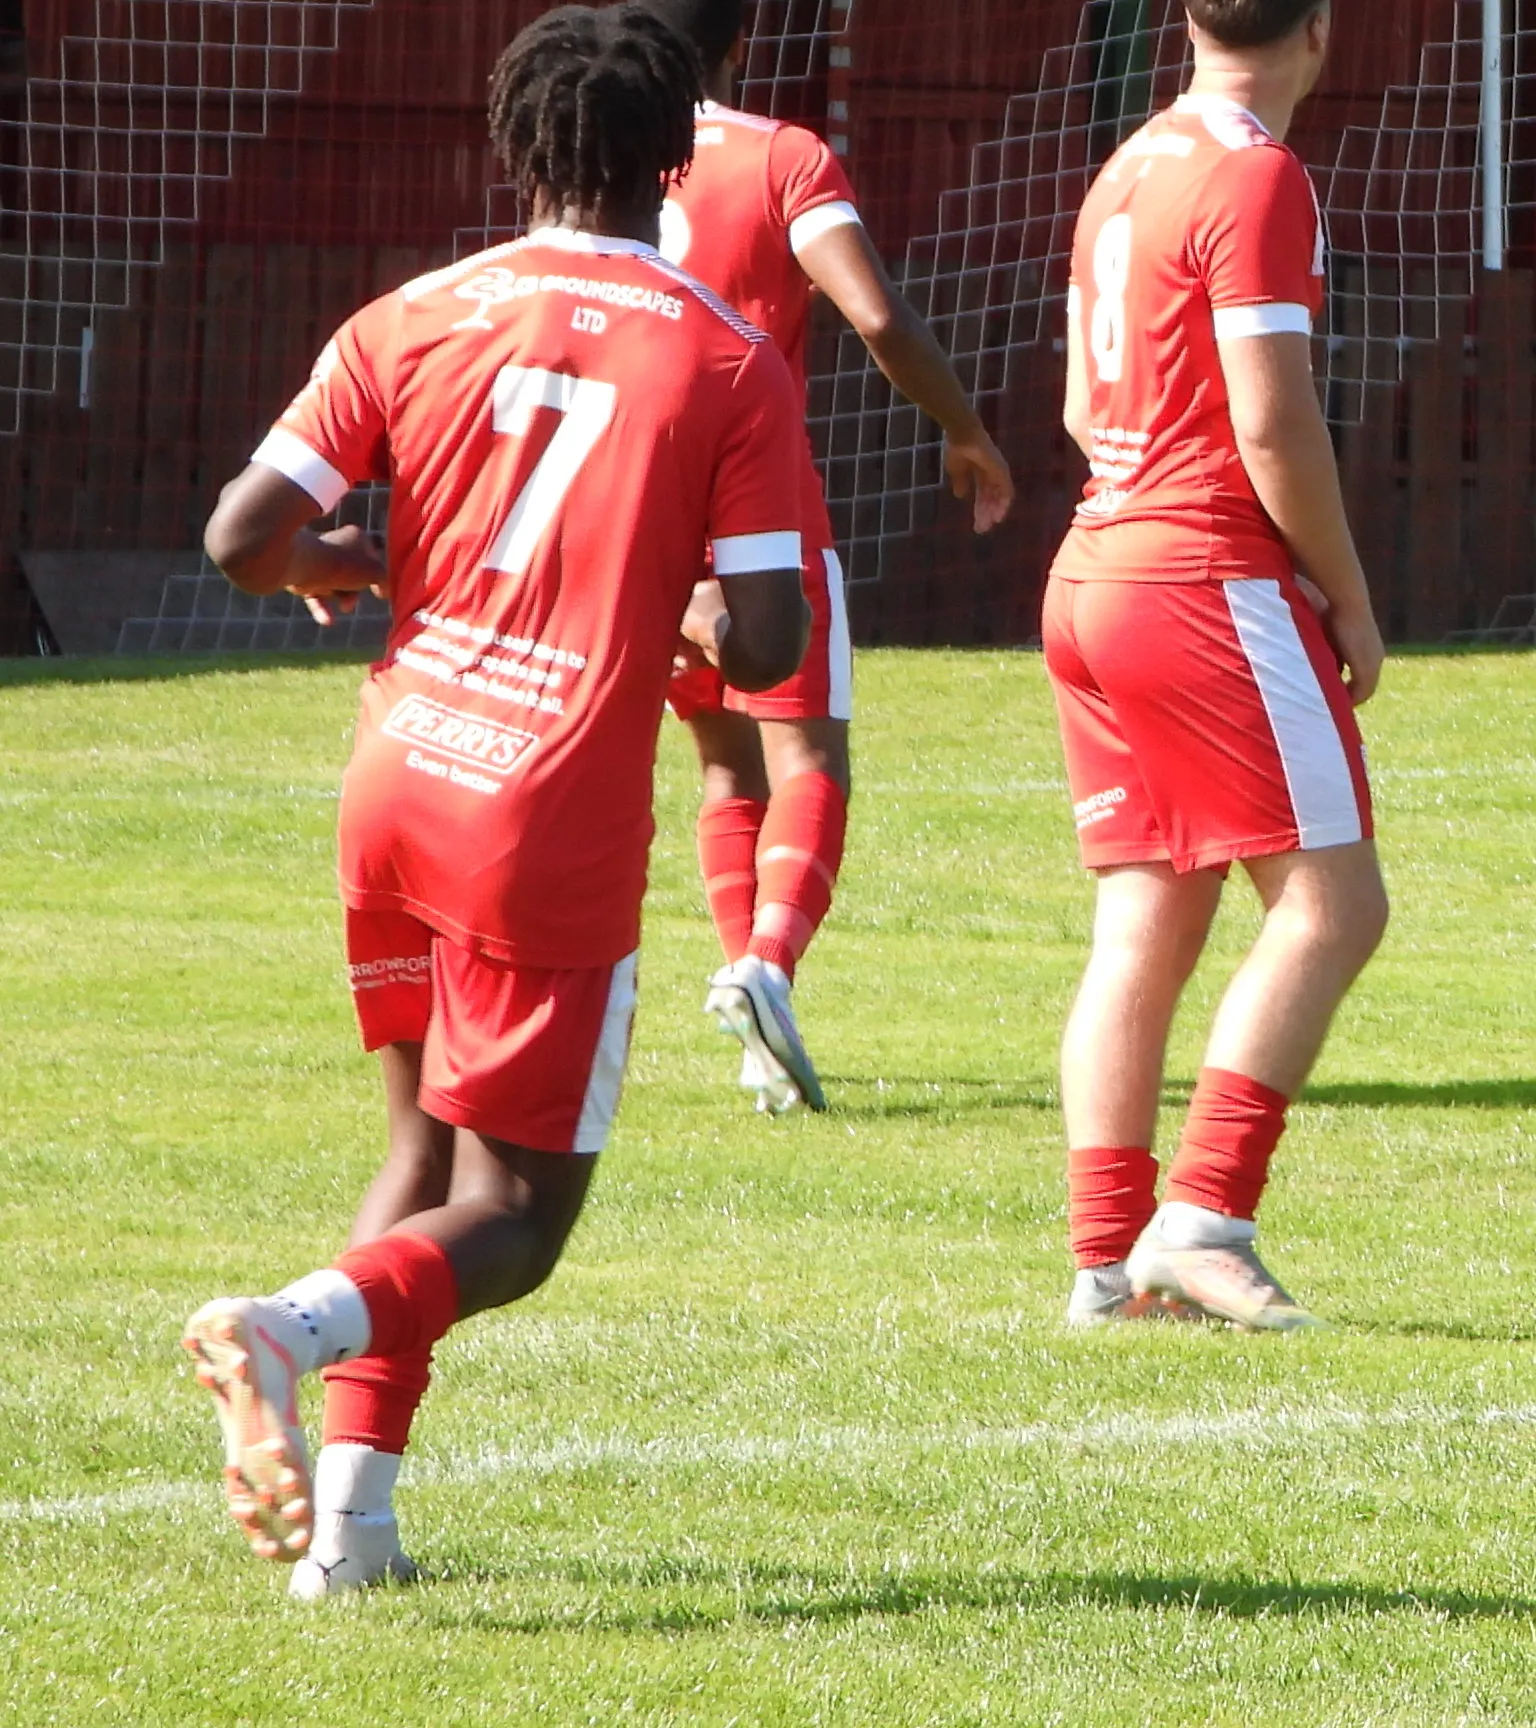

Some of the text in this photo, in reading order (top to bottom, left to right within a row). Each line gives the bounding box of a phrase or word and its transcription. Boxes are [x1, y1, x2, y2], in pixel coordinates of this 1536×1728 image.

[571, 306, 608, 335] LTD
[1093, 214, 1131, 382] 8
[482, 365, 616, 573] 7
[398, 701, 523, 765] PERRYS
